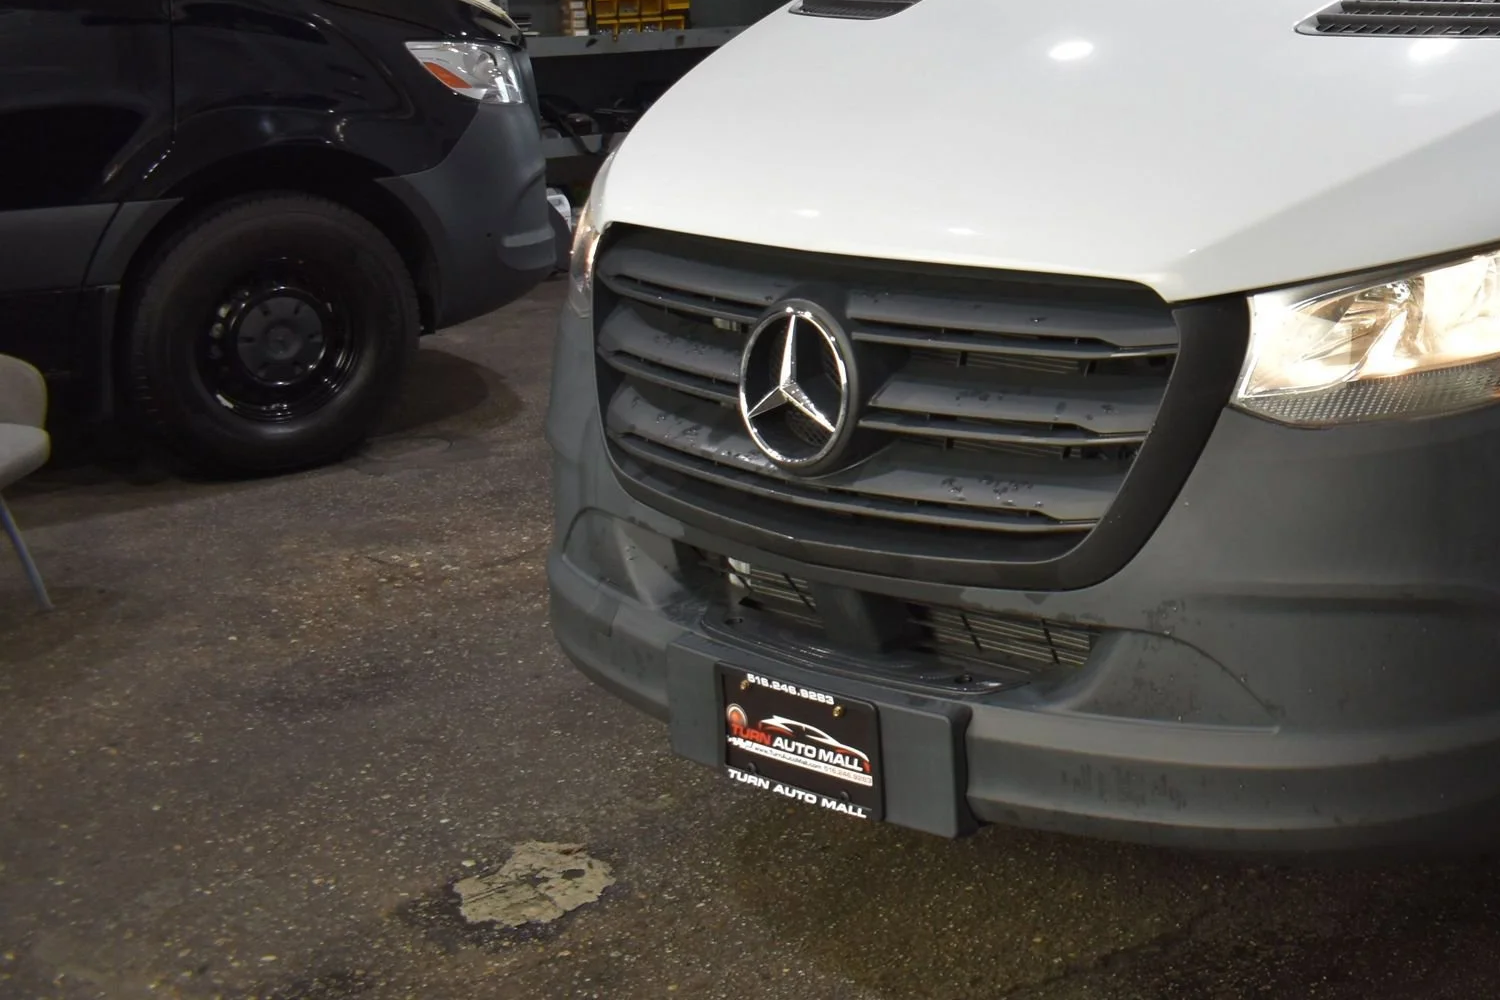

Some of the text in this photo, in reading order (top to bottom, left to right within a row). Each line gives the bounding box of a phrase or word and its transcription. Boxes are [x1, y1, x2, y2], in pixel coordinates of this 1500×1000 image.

[731, 724, 864, 772] TURN AUTO MALL
[728, 768, 867, 819] TURN AUTO MALL
